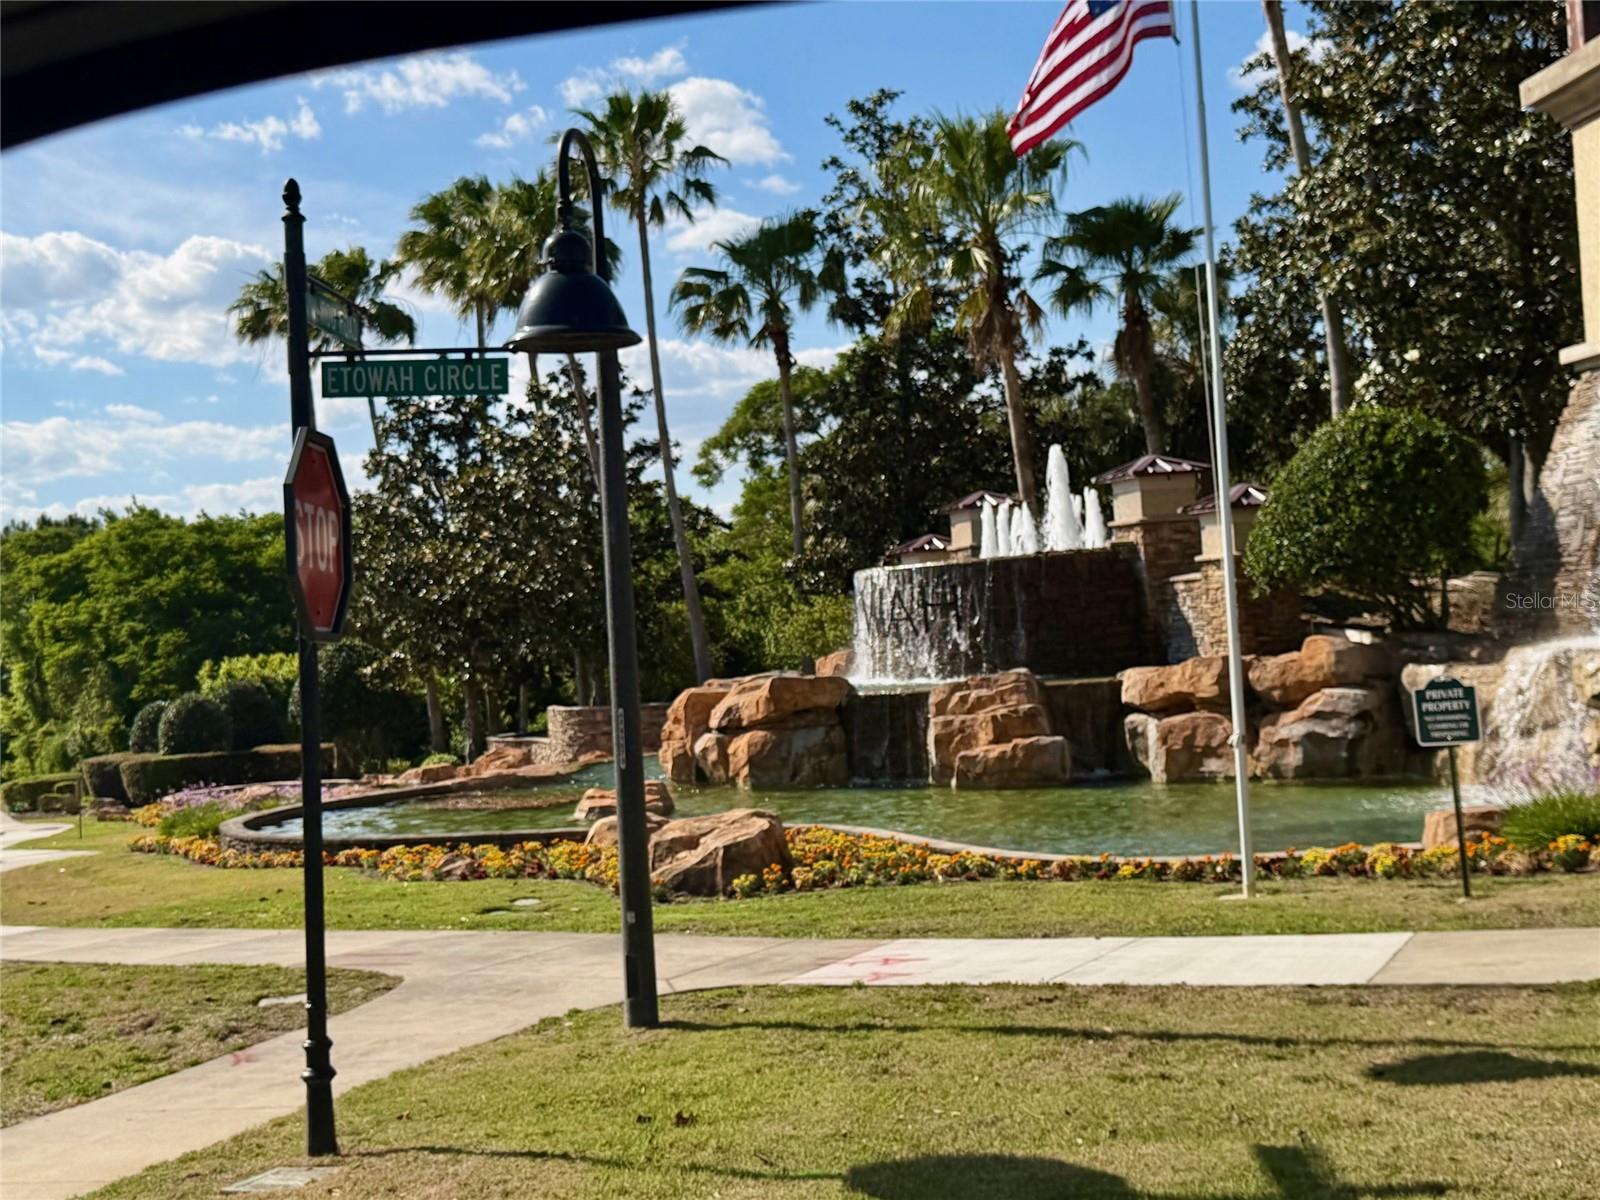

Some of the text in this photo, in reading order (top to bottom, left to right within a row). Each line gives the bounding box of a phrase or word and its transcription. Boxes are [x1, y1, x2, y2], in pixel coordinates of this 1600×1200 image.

[328, 364, 503, 393] ETOWAH CIRCLE
[295, 499, 339, 573] STOP
[1425, 688, 1465, 700] PRIVATE
[1421, 700, 1471, 712] PROPERTY
